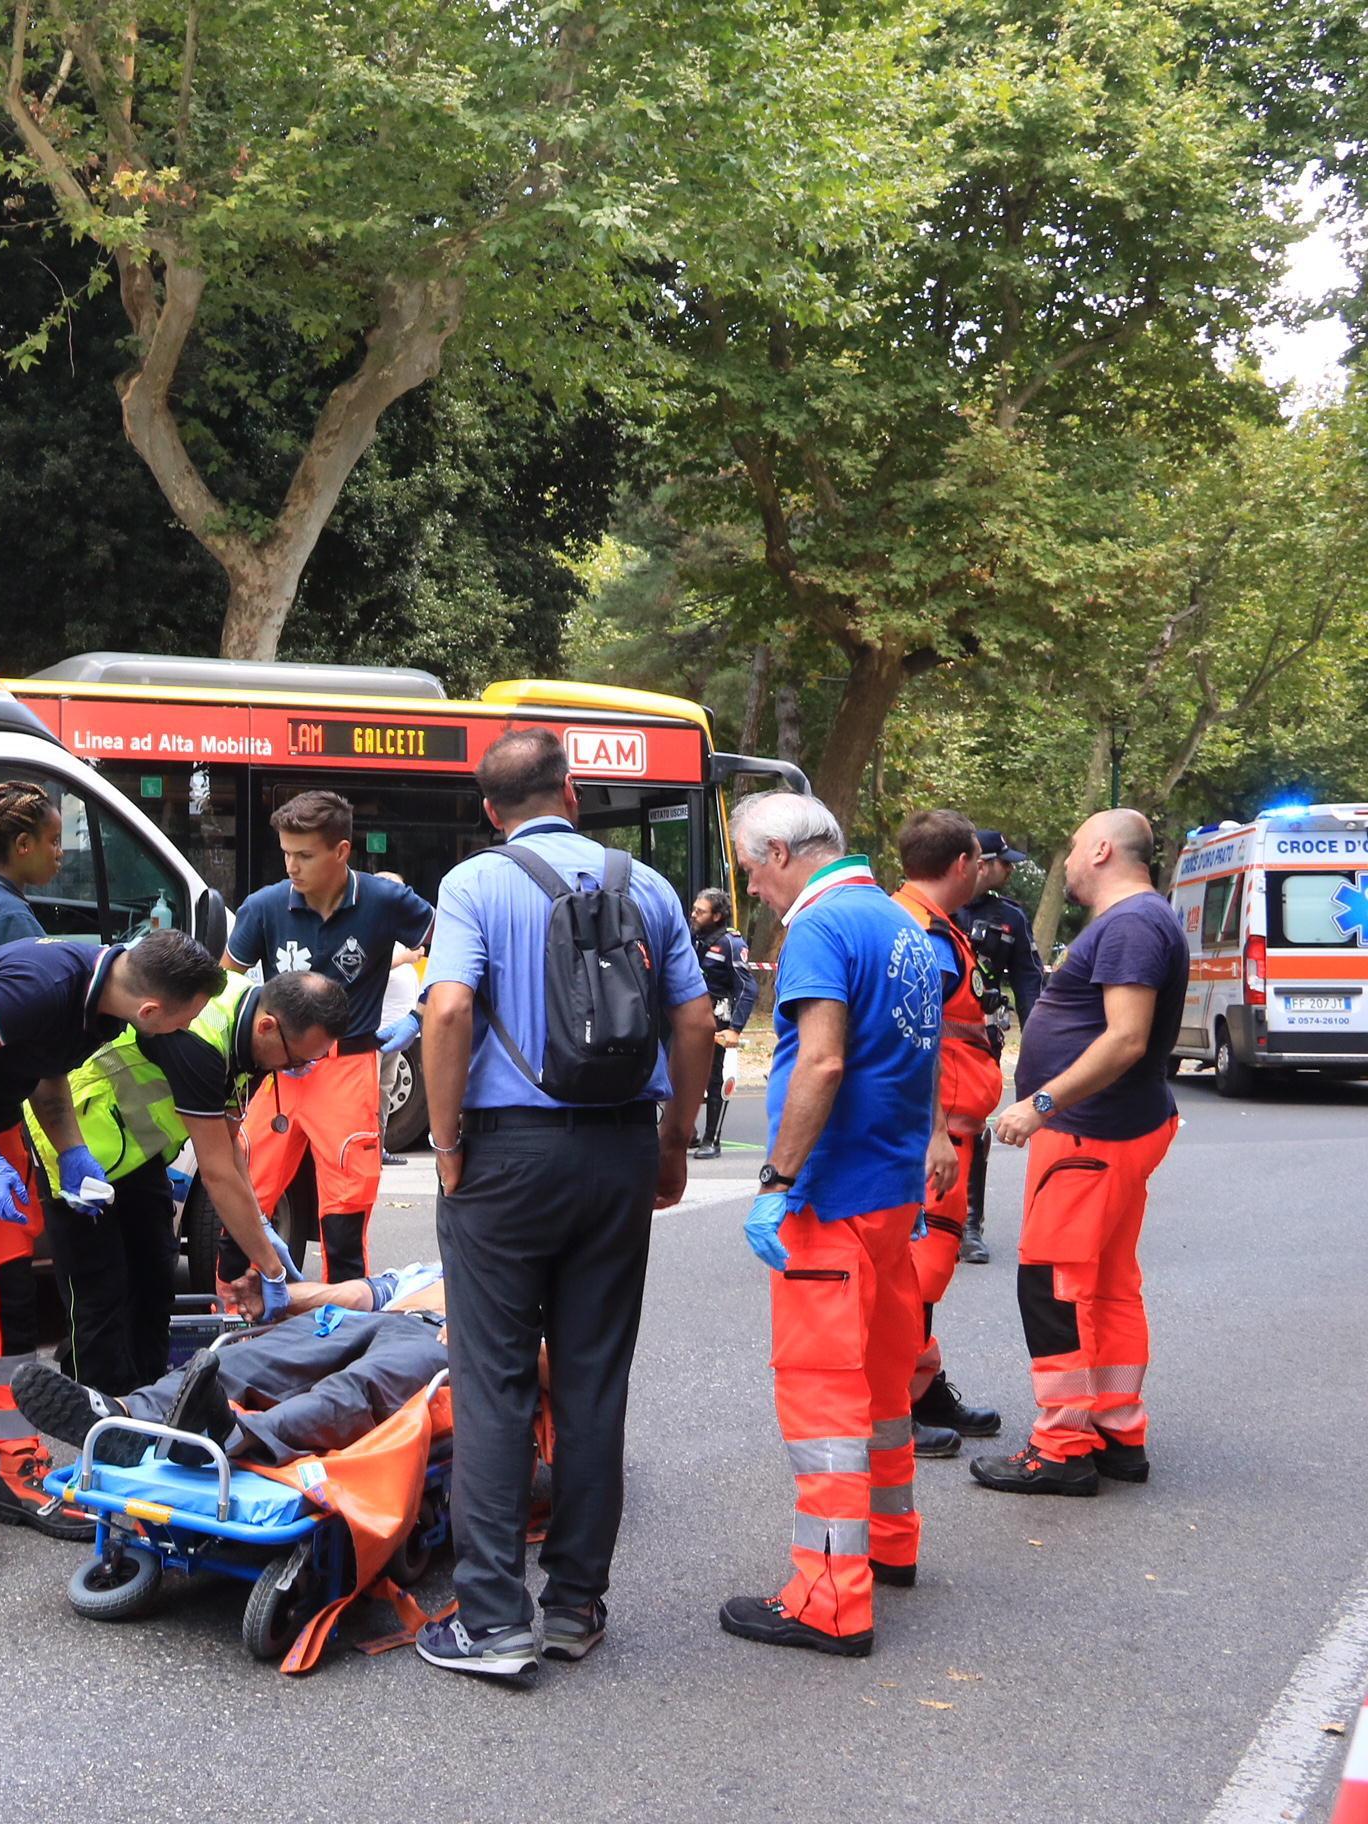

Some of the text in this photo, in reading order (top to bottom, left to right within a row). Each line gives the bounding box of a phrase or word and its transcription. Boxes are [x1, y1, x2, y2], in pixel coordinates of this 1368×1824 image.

[73, 730, 273, 756] Linea ad Alta Mobilità
[288, 722, 425, 756] LAM GALCETI
[573, 737, 636, 767] LAM
[1277, 840, 1338, 854] CROCE
[1292, 998, 1305, 1009] FF
